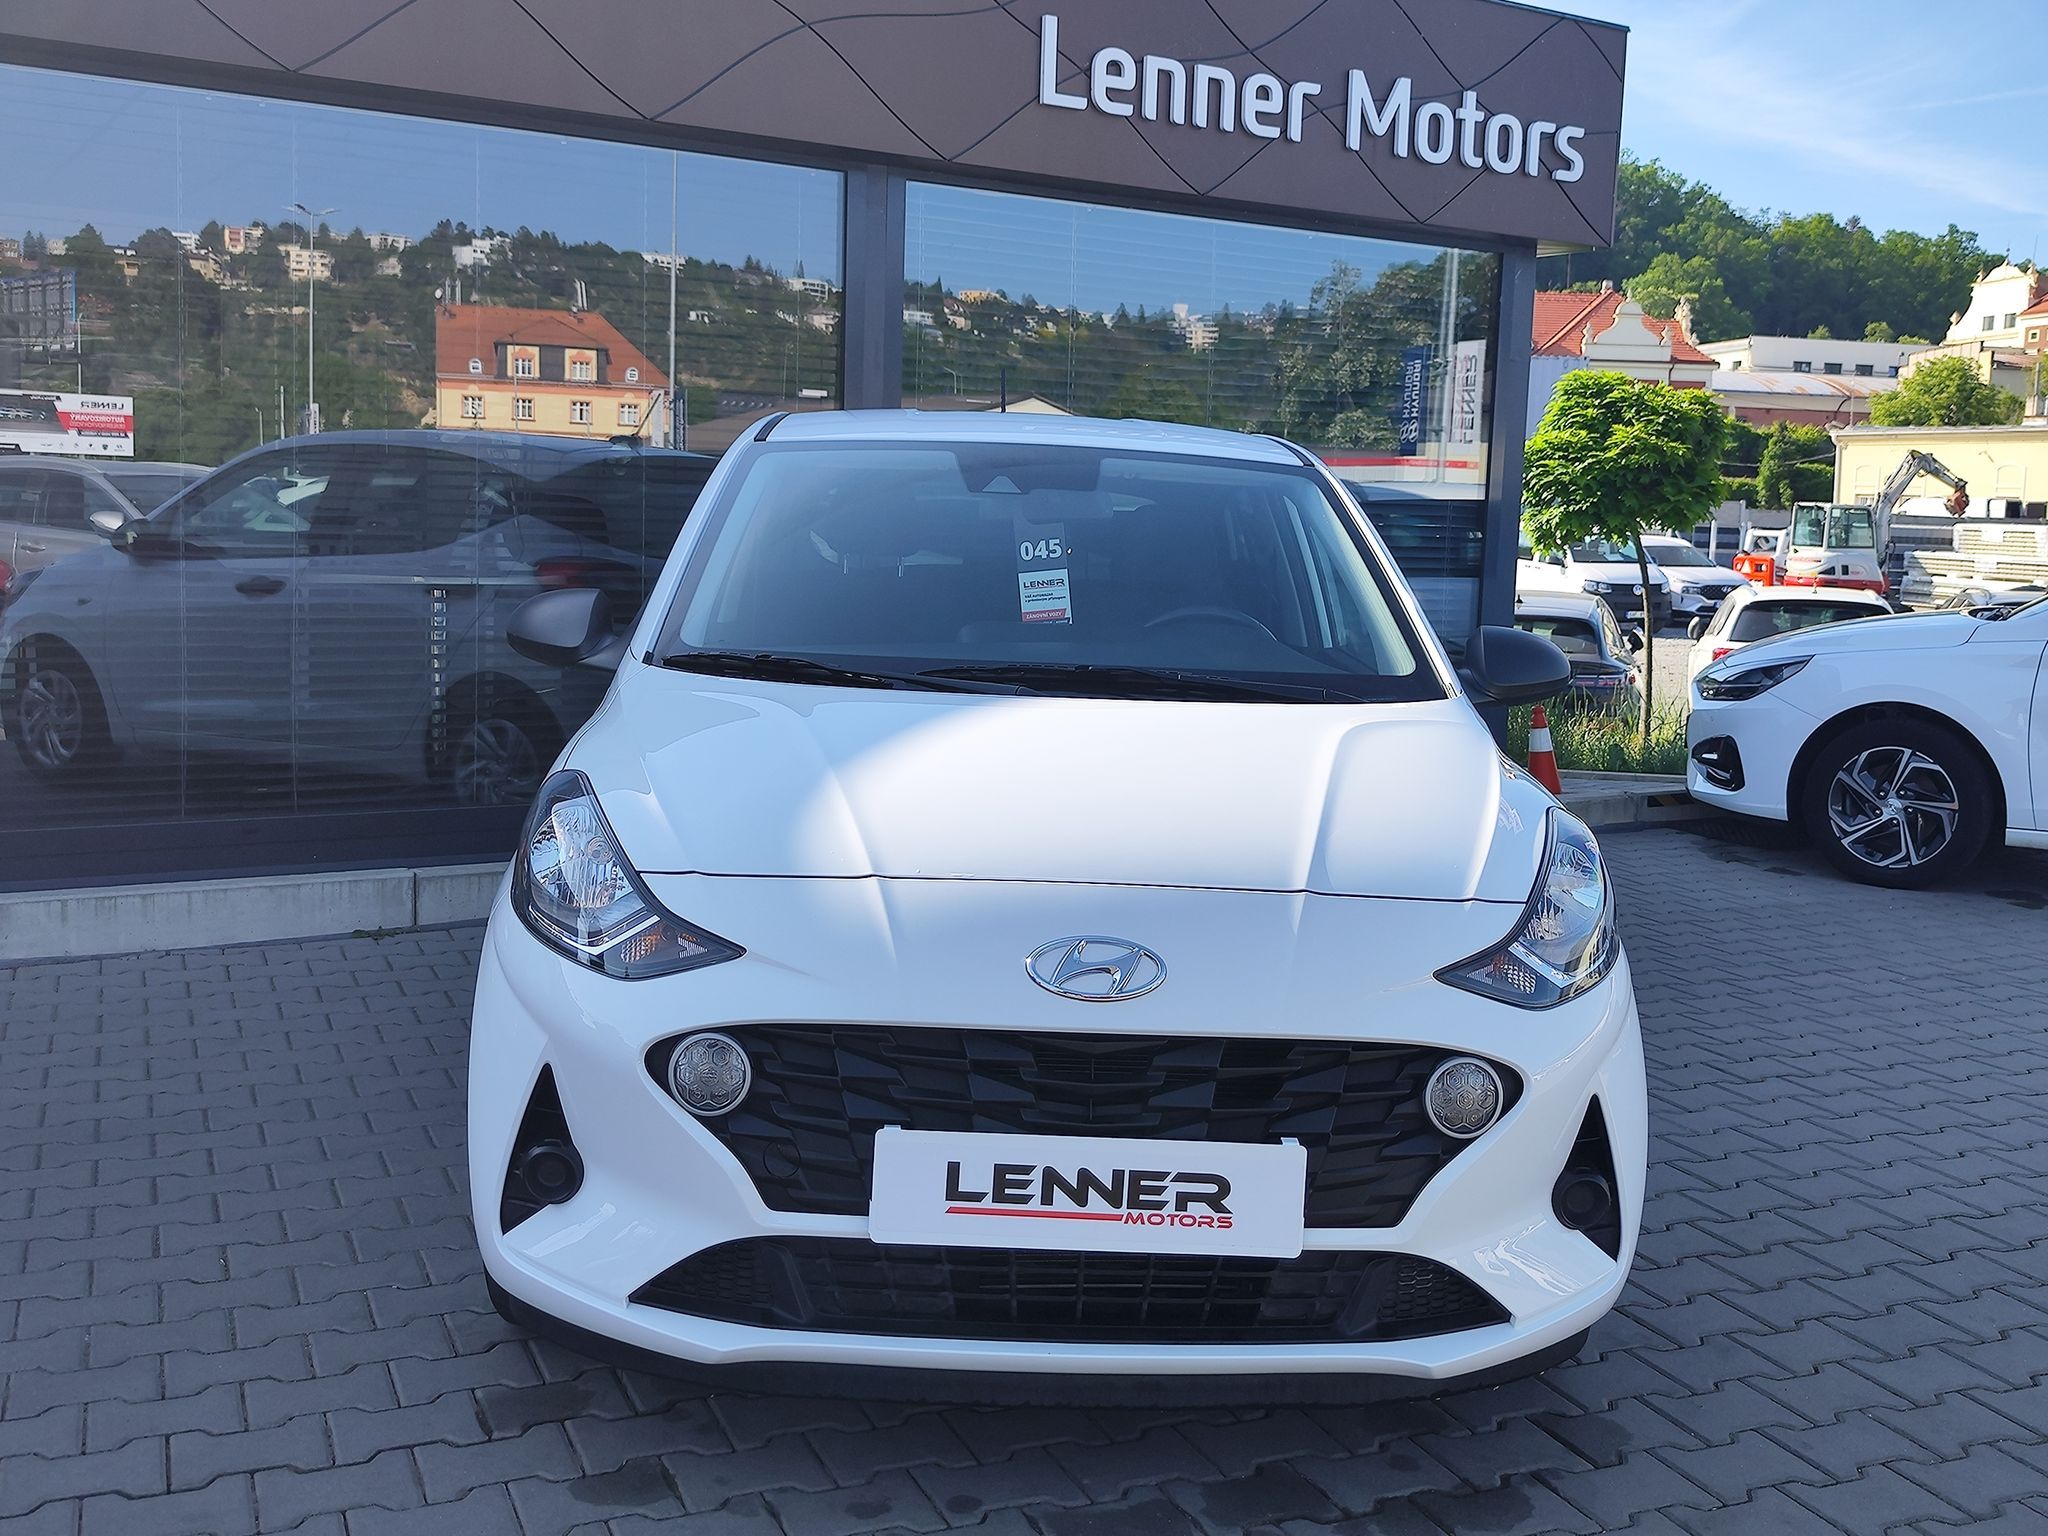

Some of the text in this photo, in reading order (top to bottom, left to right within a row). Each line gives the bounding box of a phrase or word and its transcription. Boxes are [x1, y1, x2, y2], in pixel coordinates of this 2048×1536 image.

[1040, 14, 1586, 183] Lenner Motors
[1020, 539, 1062, 560] 045
[1023, 578, 1065, 588] LENNER
[945, 1160, 1234, 1214] LENNER
[1123, 1211, 1234, 1229] MOTORS
